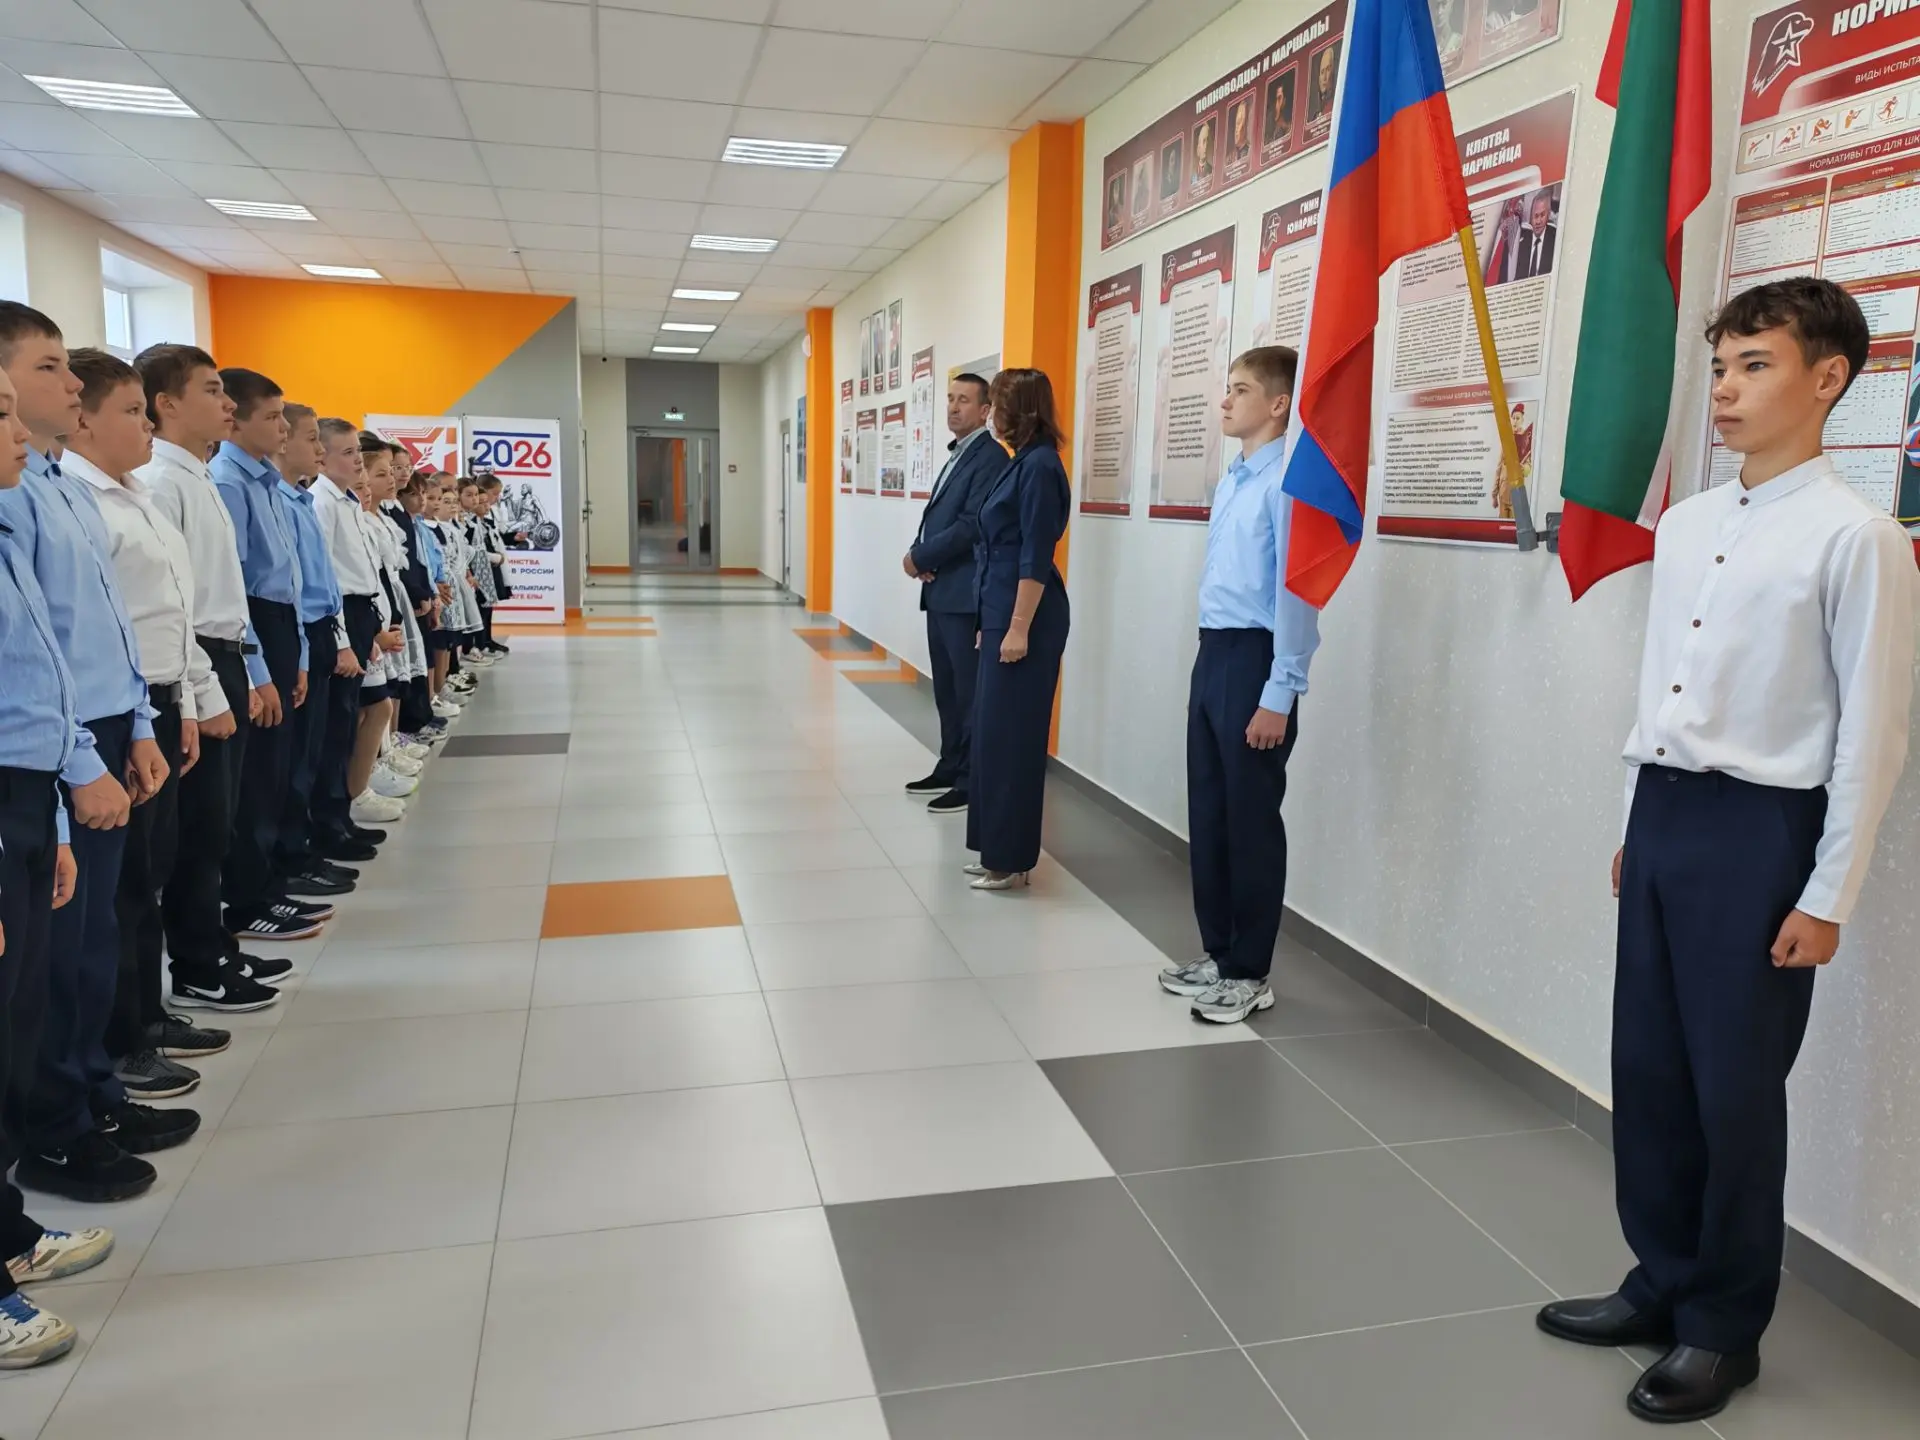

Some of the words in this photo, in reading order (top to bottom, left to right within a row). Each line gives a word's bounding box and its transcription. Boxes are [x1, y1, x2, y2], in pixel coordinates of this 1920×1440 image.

[1831, 0, 1920, 37] НОРМ
[1196, 61, 1261, 114] ПОЛКОВОДЦЫ
[1263, 55, 1270, 73] И
[1271, 15, 1330, 67] МАРШАЛЫ
[1855, 68, 1882, 84] ВИДЫ
[1466, 128, 1509, 157] КЛЯТВА
[1809, 149, 1863, 169] НОРМАТИВЫ
[1865, 144, 1882, 155] ГТО
[1882, 138, 1902, 152] ДЛЯ
[1300, 197, 1320, 214] ГИМН
[472, 438, 552, 469] 2026
